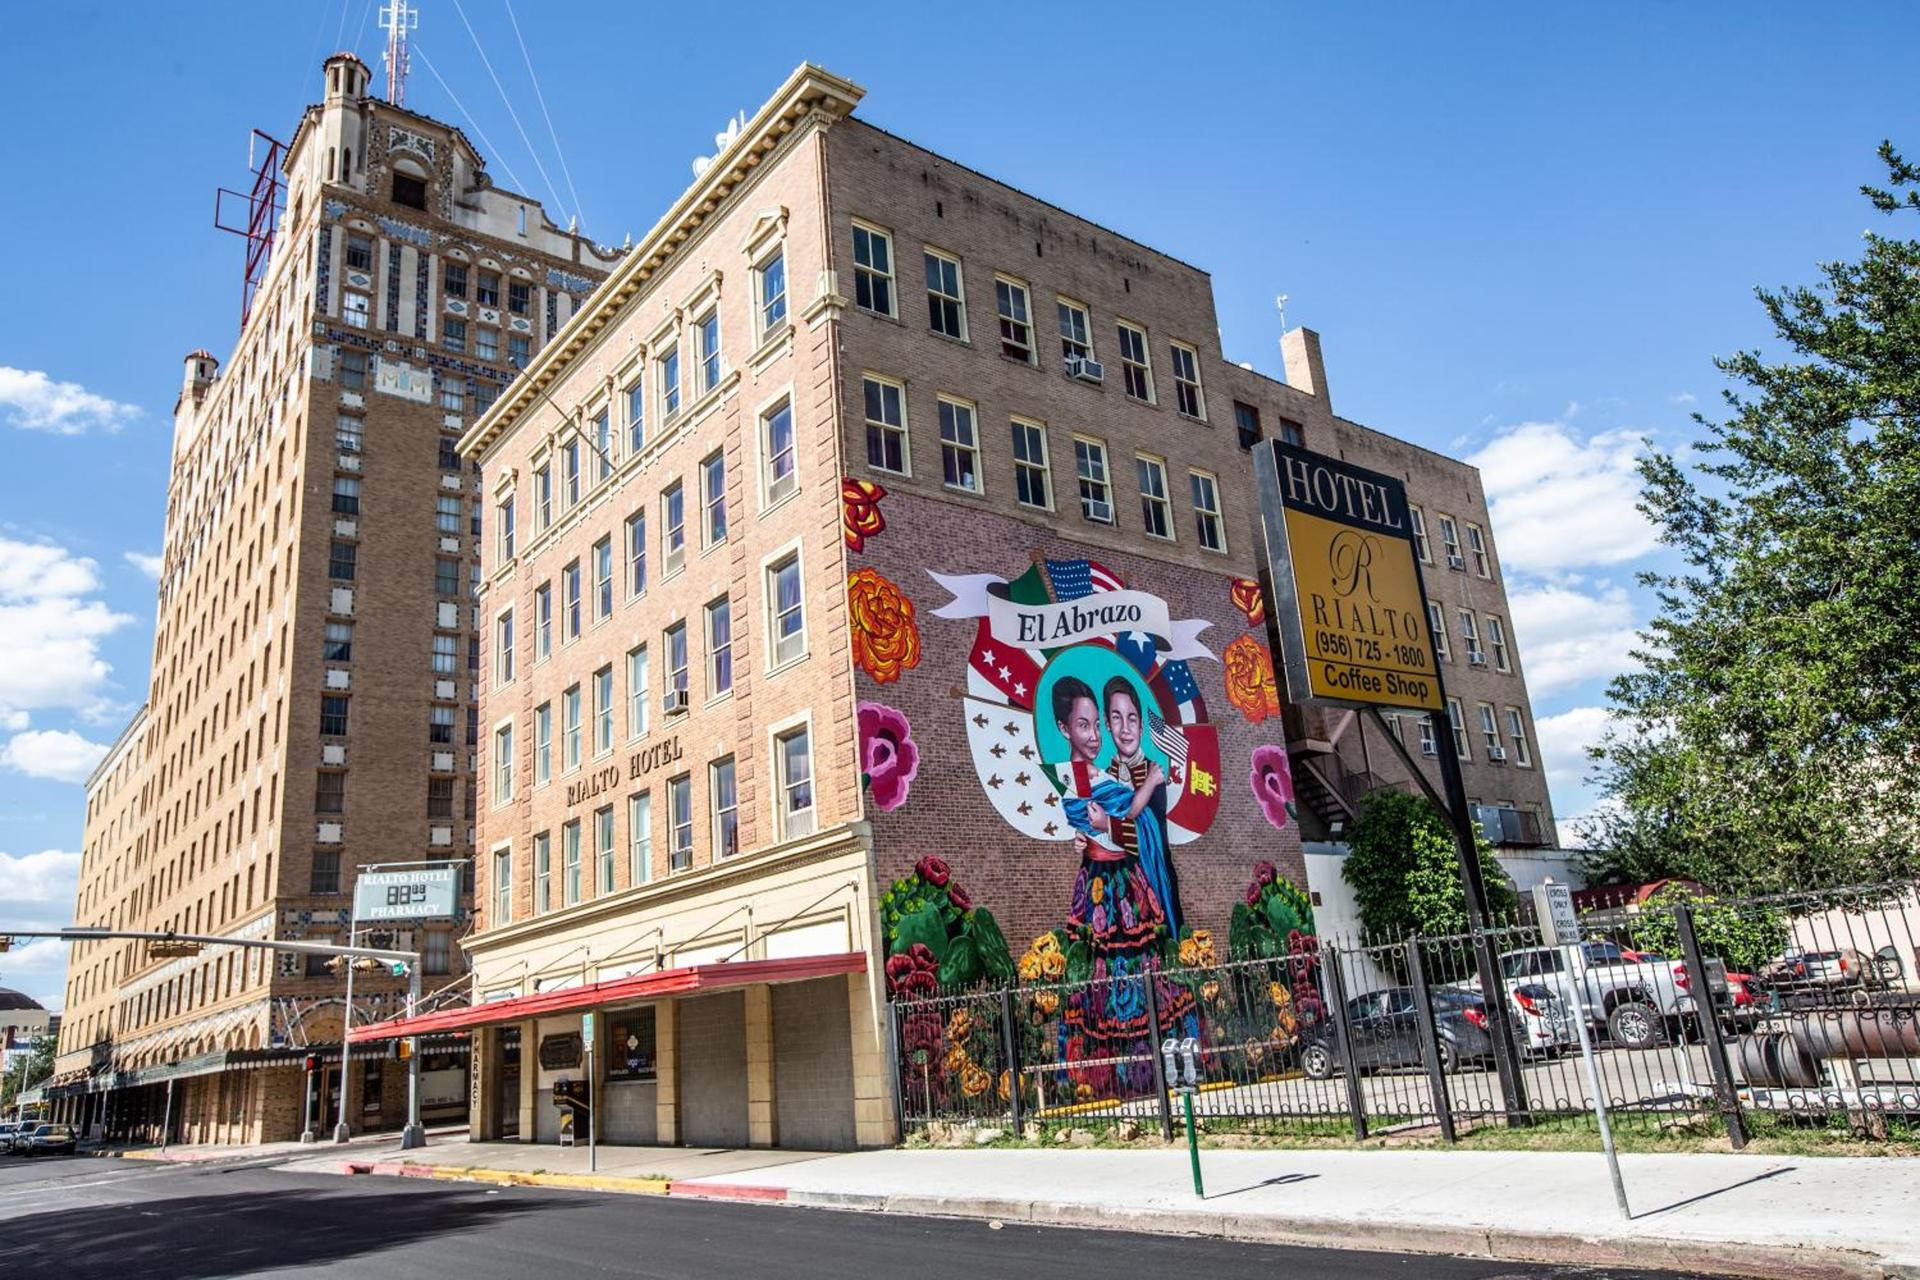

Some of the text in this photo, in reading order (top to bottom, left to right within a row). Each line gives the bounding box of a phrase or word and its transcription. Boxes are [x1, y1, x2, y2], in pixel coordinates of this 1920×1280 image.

[1282, 455, 1402, 529] HOTEL
[1329, 530, 1384, 604] R
[1017, 604, 1142, 642] El Abrazo
[1311, 593, 1419, 642] RIALTO
[1315, 630, 1353, 662] (956)
[1323, 663, 1429, 705] Coffee Shop
[566, 735, 683, 808] RIALTO HOTEL
[364, 870, 449, 886] RIALTO HOTEL
[1550, 888, 1567, 898] CROSS
[370, 903, 440, 918] PHARMACY
